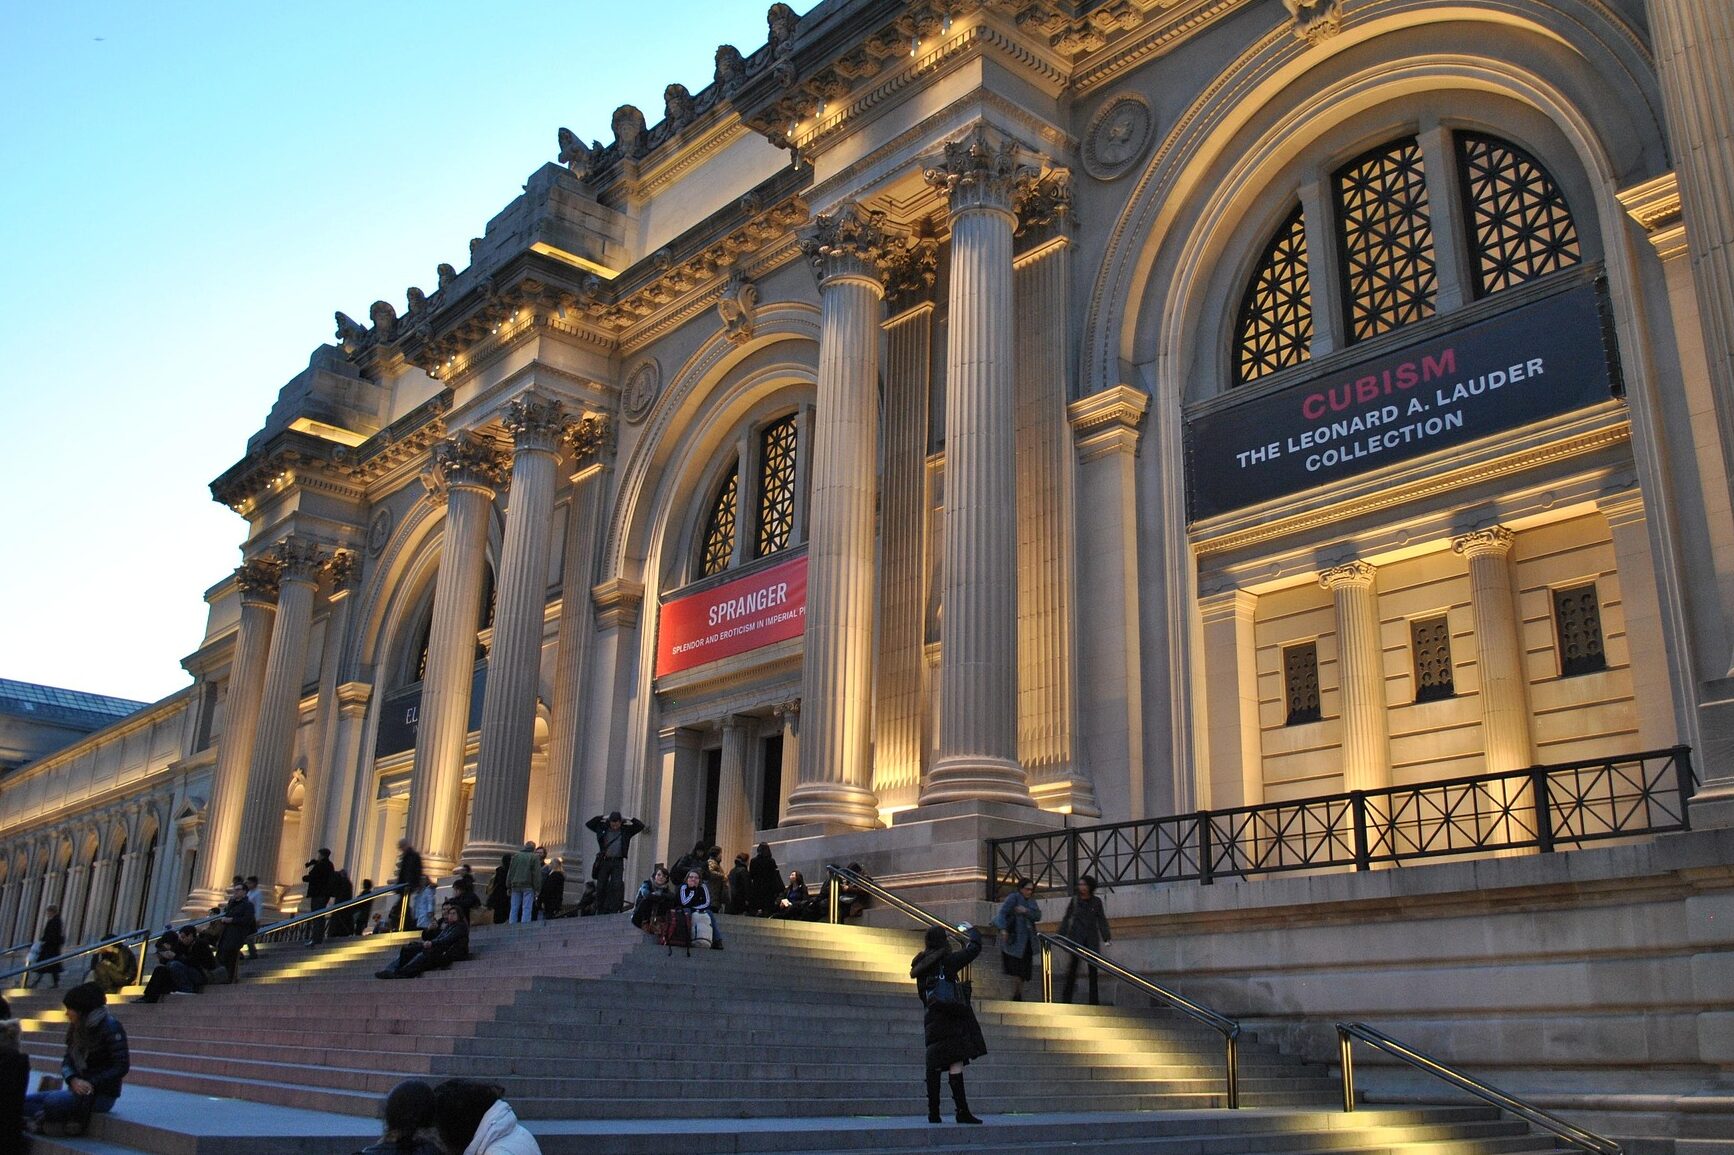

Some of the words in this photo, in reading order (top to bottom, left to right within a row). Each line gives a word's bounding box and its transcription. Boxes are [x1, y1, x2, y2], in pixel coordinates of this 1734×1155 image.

[1303, 349, 1457, 420] CUBISM
[1236, 441, 1280, 468] THE
[1288, 405, 1399, 452] LEONARD
[1407, 398, 1429, 416] A.
[1436, 358, 1544, 406] LAUDER
[1305, 410, 1464, 472] COLLECTION
[708, 582, 787, 626] SPRANGER
[672, 639, 704, 655] SPLENDOR
[705, 634, 719, 645] AND
[720, 622, 756, 640] EROTICISM
[757, 619, 764, 629] IN
[765, 611, 798, 627] IMPERIAL
[406, 706, 418, 724] EL
